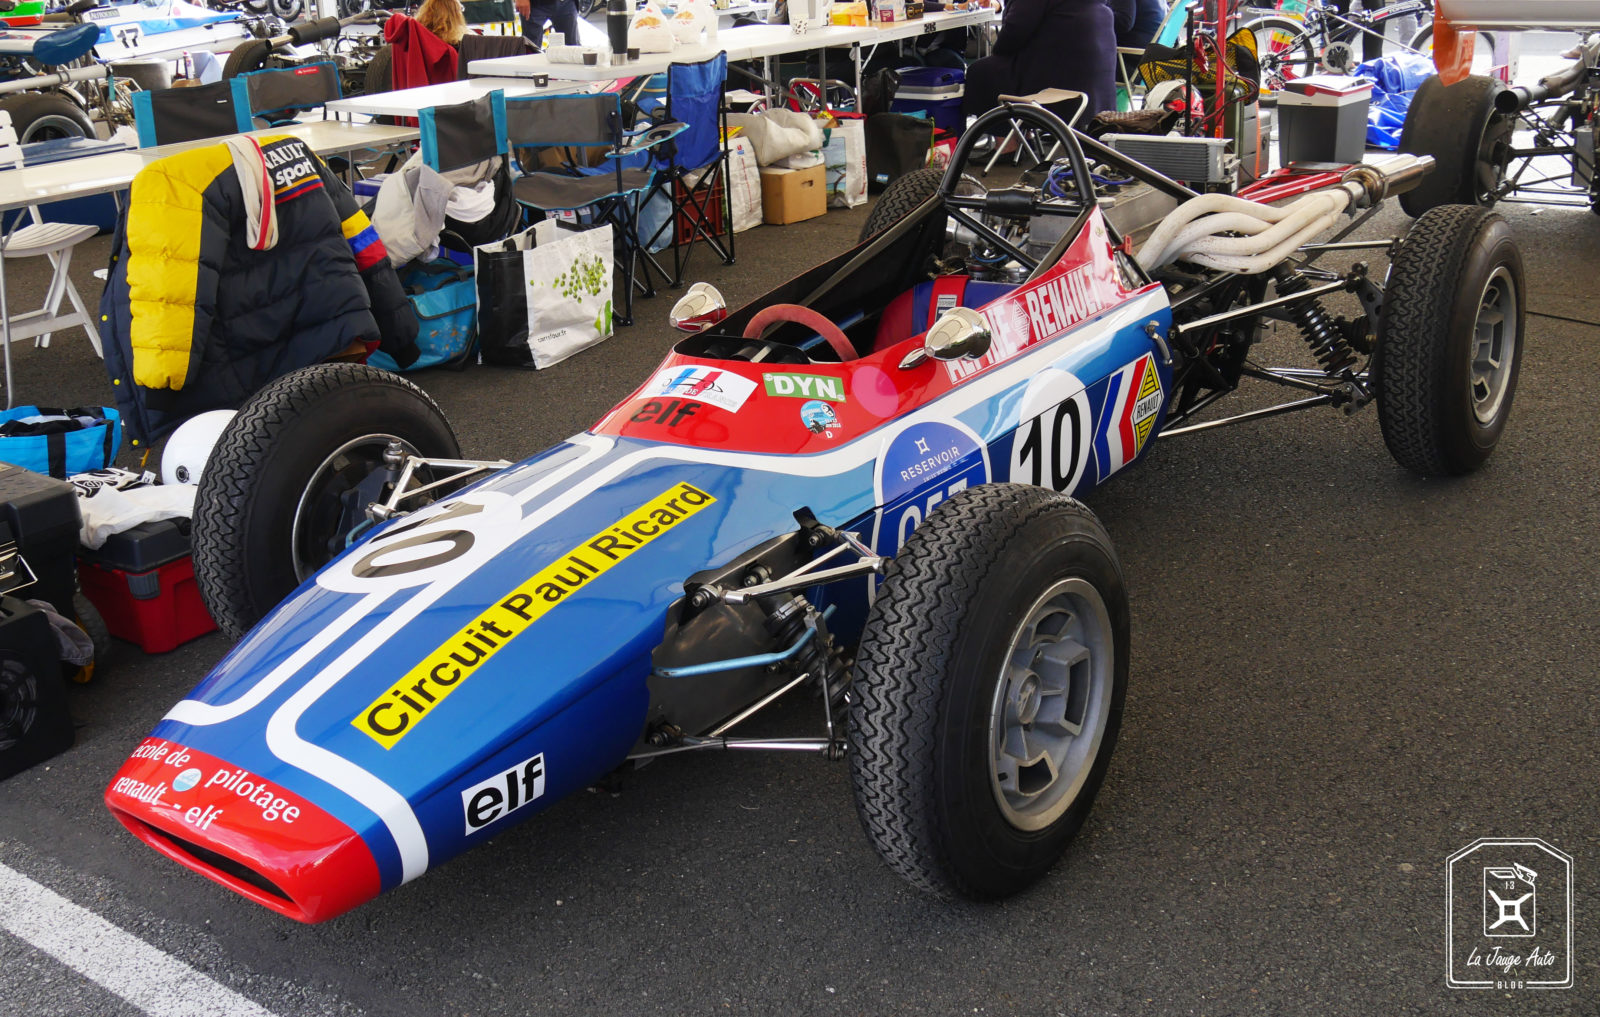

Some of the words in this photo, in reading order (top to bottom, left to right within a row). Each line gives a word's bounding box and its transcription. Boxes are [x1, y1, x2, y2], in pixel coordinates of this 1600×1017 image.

[117, 28, 138, 48] 17
[1025, 263, 1105, 341] RENAULT
[630, 400, 702, 427] elf
[773, 375, 837, 399] DYN
[1136, 393, 1160, 420] RENAULT
[900, 446, 960, 482] RESERVOIR
[1020, 397, 1081, 493] 10
[367, 618, 513, 737] Circuit
[501, 556, 600, 621] Paul
[588, 484, 711, 560] Ricard
[112, 776, 168, 806] renault
[184, 805, 223, 831] elf
[131, 740, 168, 761] école
[165, 747, 191, 767] de
[204, 769, 300, 823] pilotage
[467, 756, 543, 828] elf
